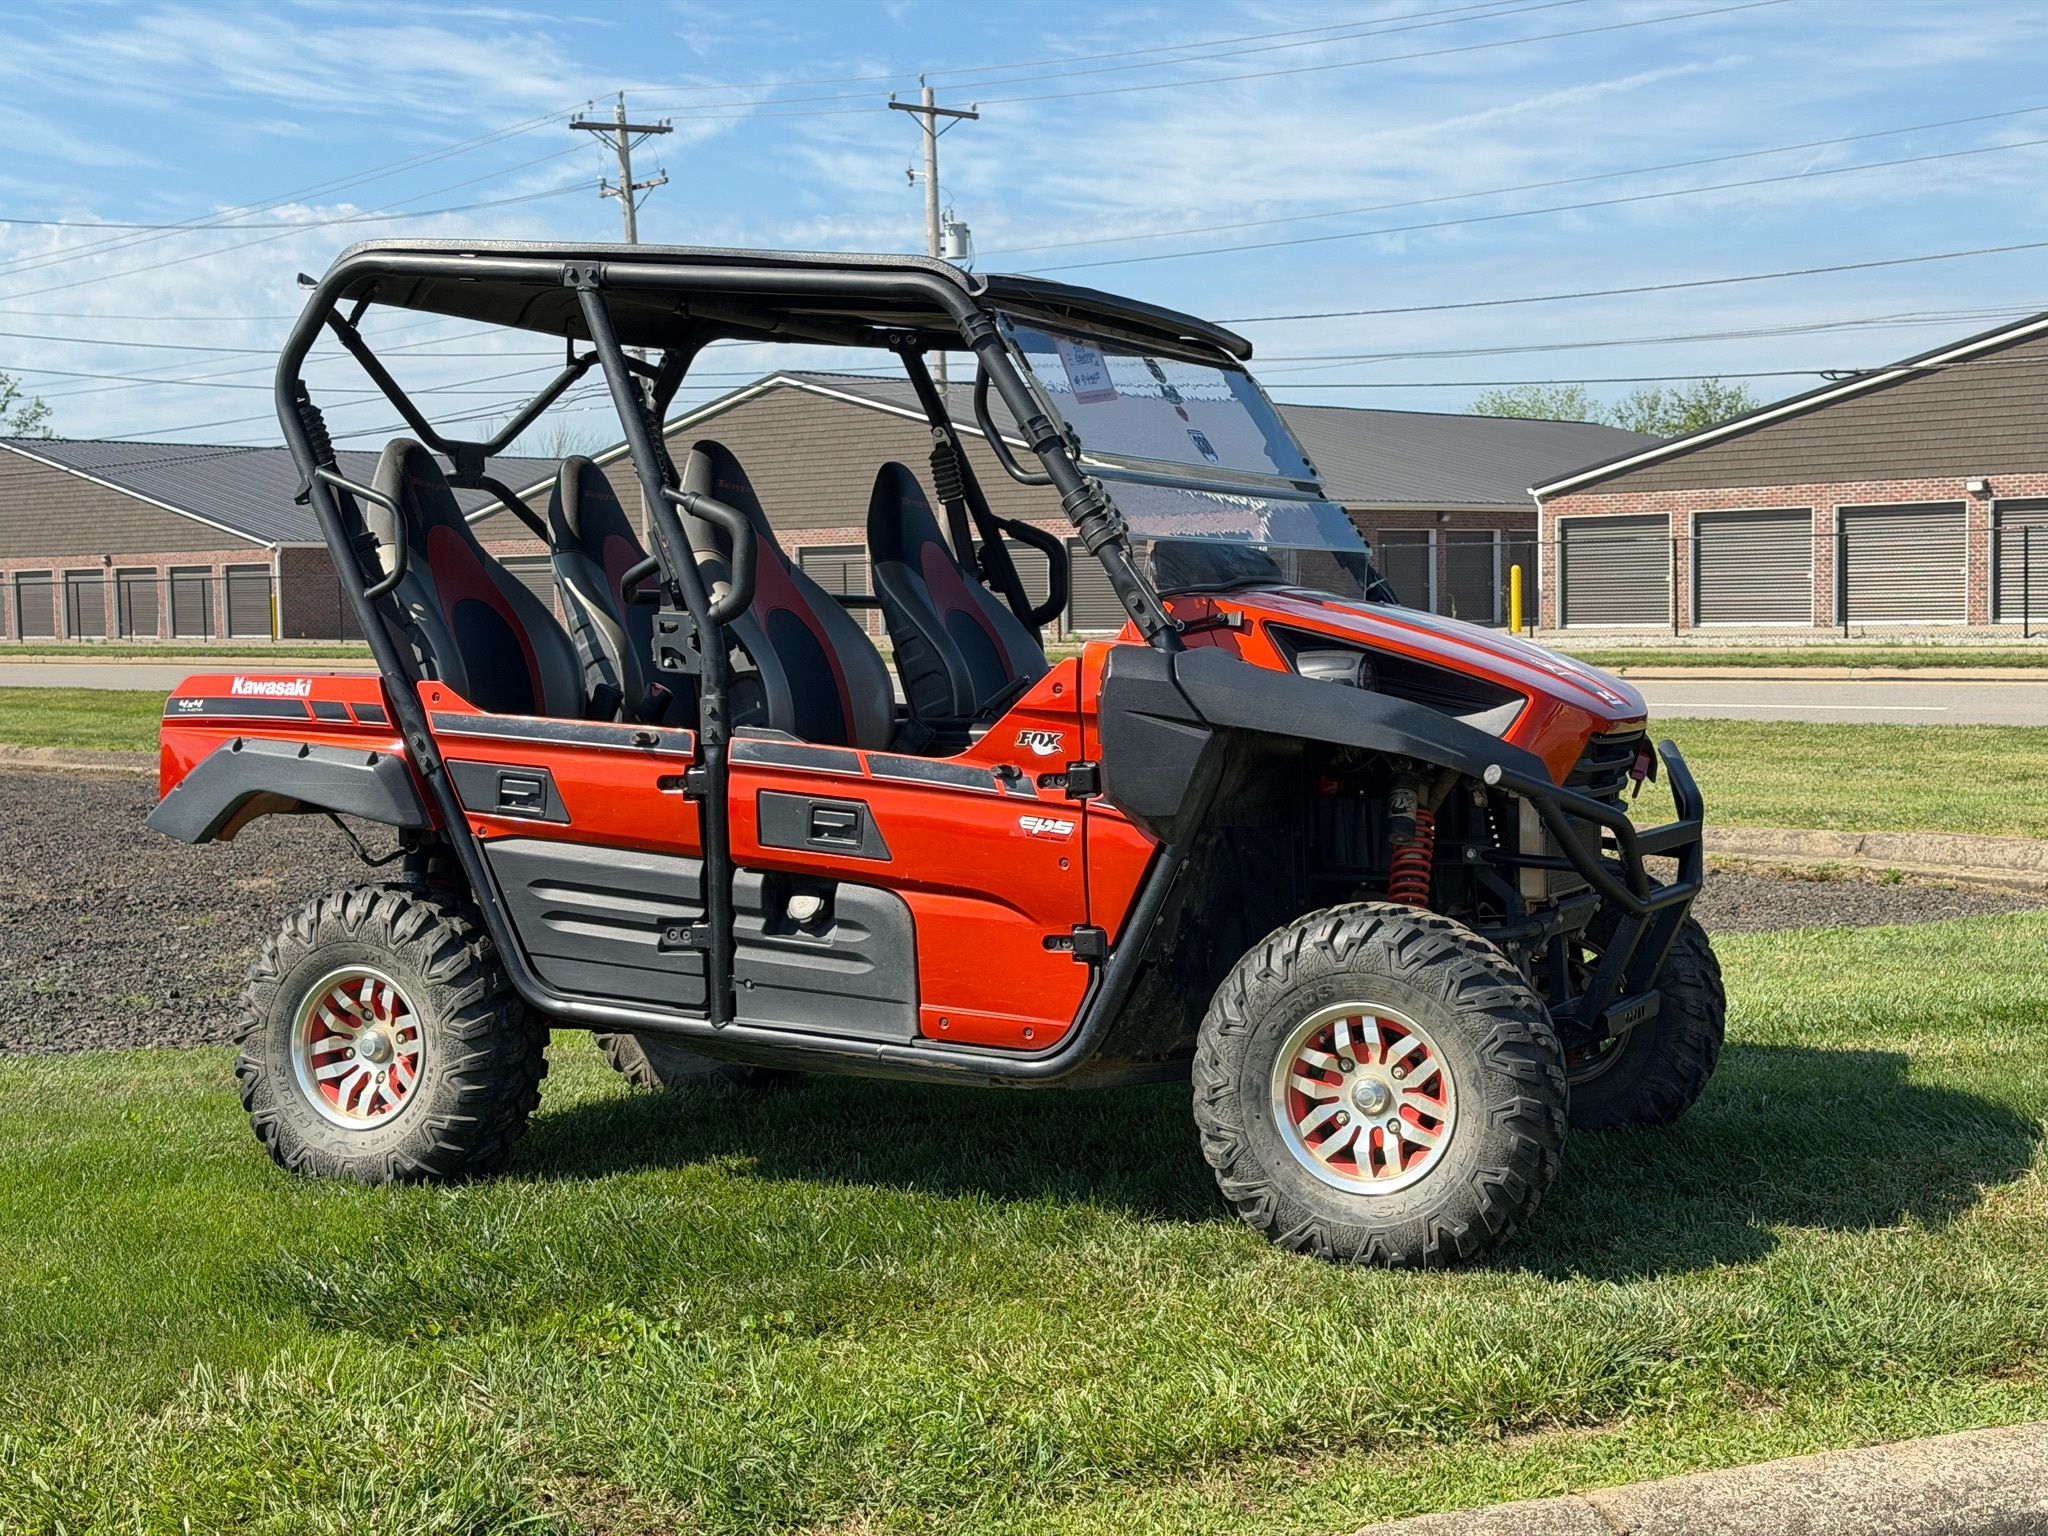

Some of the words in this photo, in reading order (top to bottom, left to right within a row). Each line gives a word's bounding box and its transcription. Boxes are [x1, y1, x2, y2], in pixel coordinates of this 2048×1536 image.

[231, 676, 312, 697] Kawasaki
[1018, 730, 1063, 749] FOX
[1265, 984, 1335, 1040] CEROS
